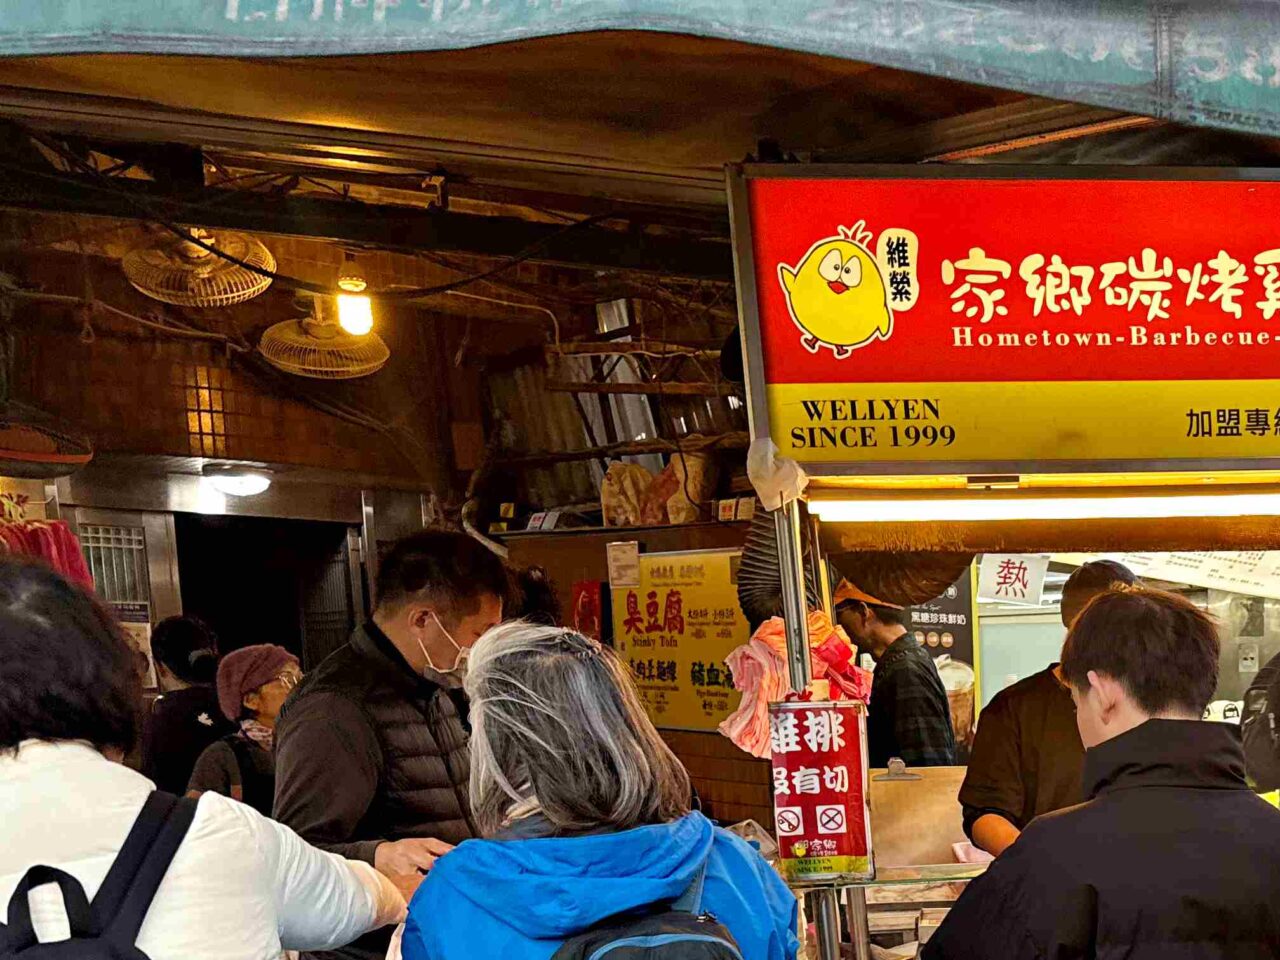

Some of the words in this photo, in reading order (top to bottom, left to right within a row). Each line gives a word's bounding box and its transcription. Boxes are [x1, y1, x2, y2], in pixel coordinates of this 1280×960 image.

[801, 398, 941, 423] WELLYEN
[790, 425, 878, 450] SINCE
[888, 424, 956, 449] 1999
[996, 558, 1029, 599] 熱
[622, 588, 685, 636] 臭豆腐
